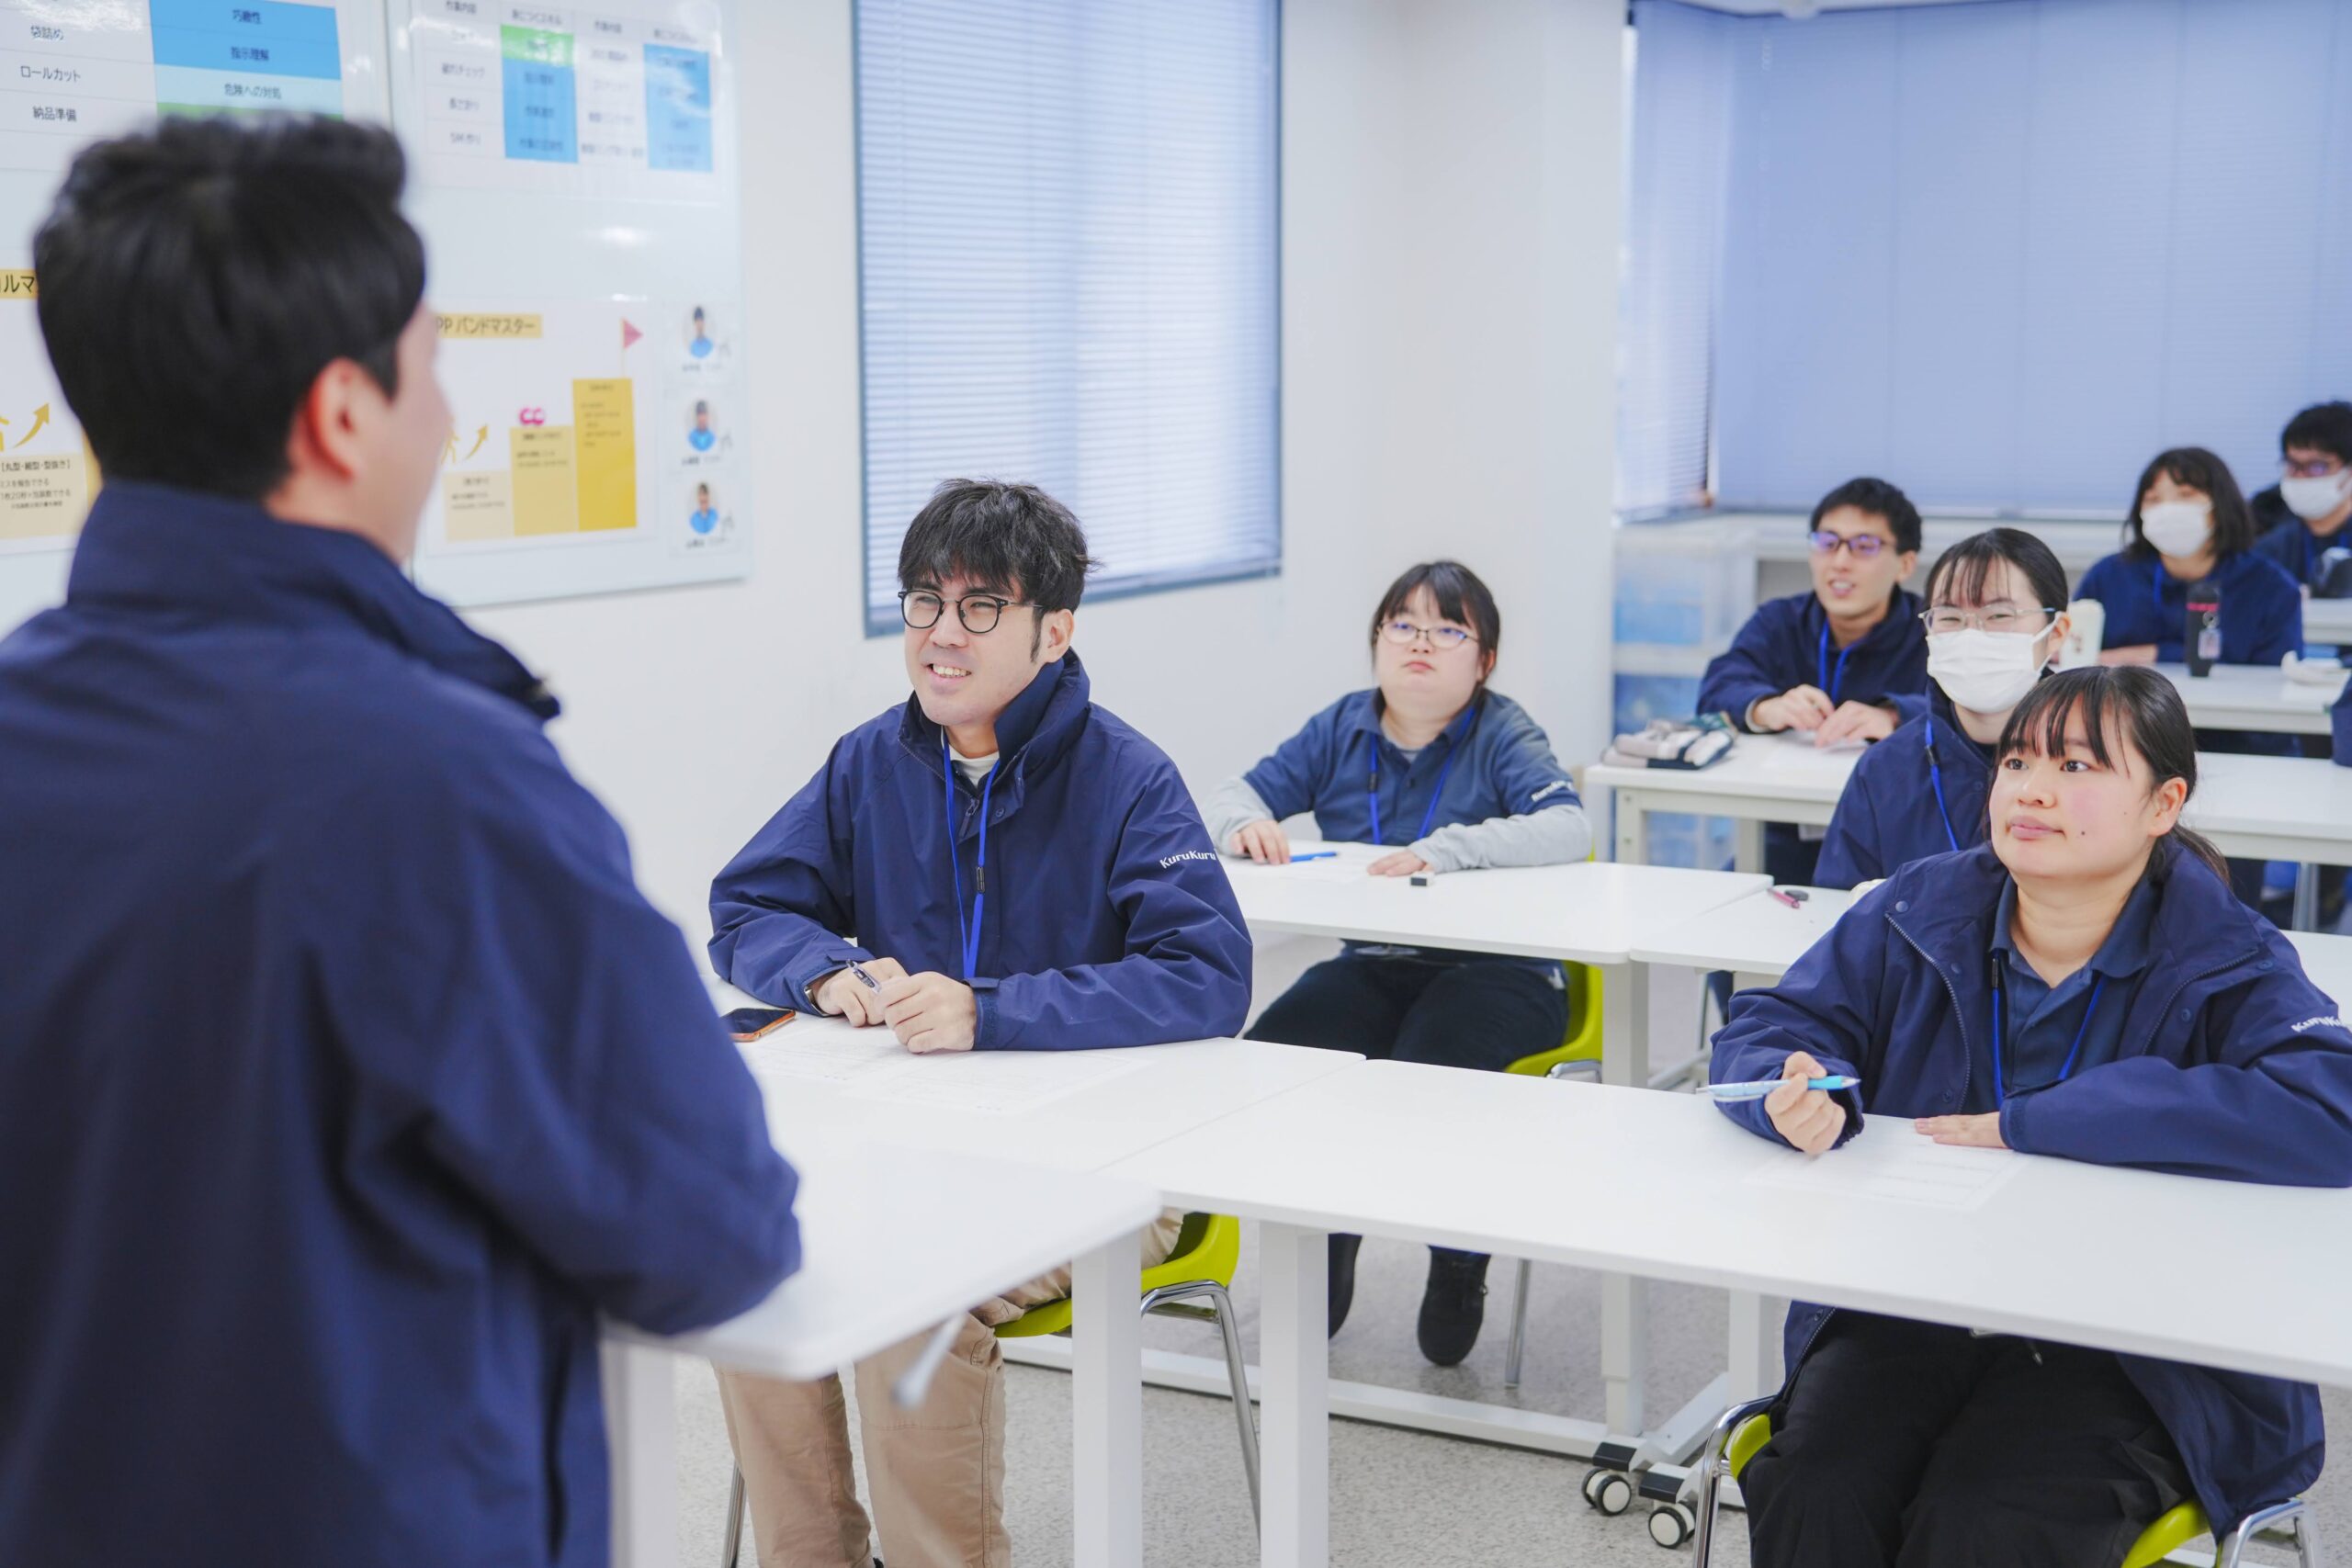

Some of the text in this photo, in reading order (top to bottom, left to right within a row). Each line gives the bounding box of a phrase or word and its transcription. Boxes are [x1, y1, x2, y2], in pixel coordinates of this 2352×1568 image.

[20, 65, 81, 83] ロールカット
[32, 106, 77, 122] 納品準備
[455, 315, 536, 334] バンドマスター
[1159, 850, 1217, 869] KuruKuru
